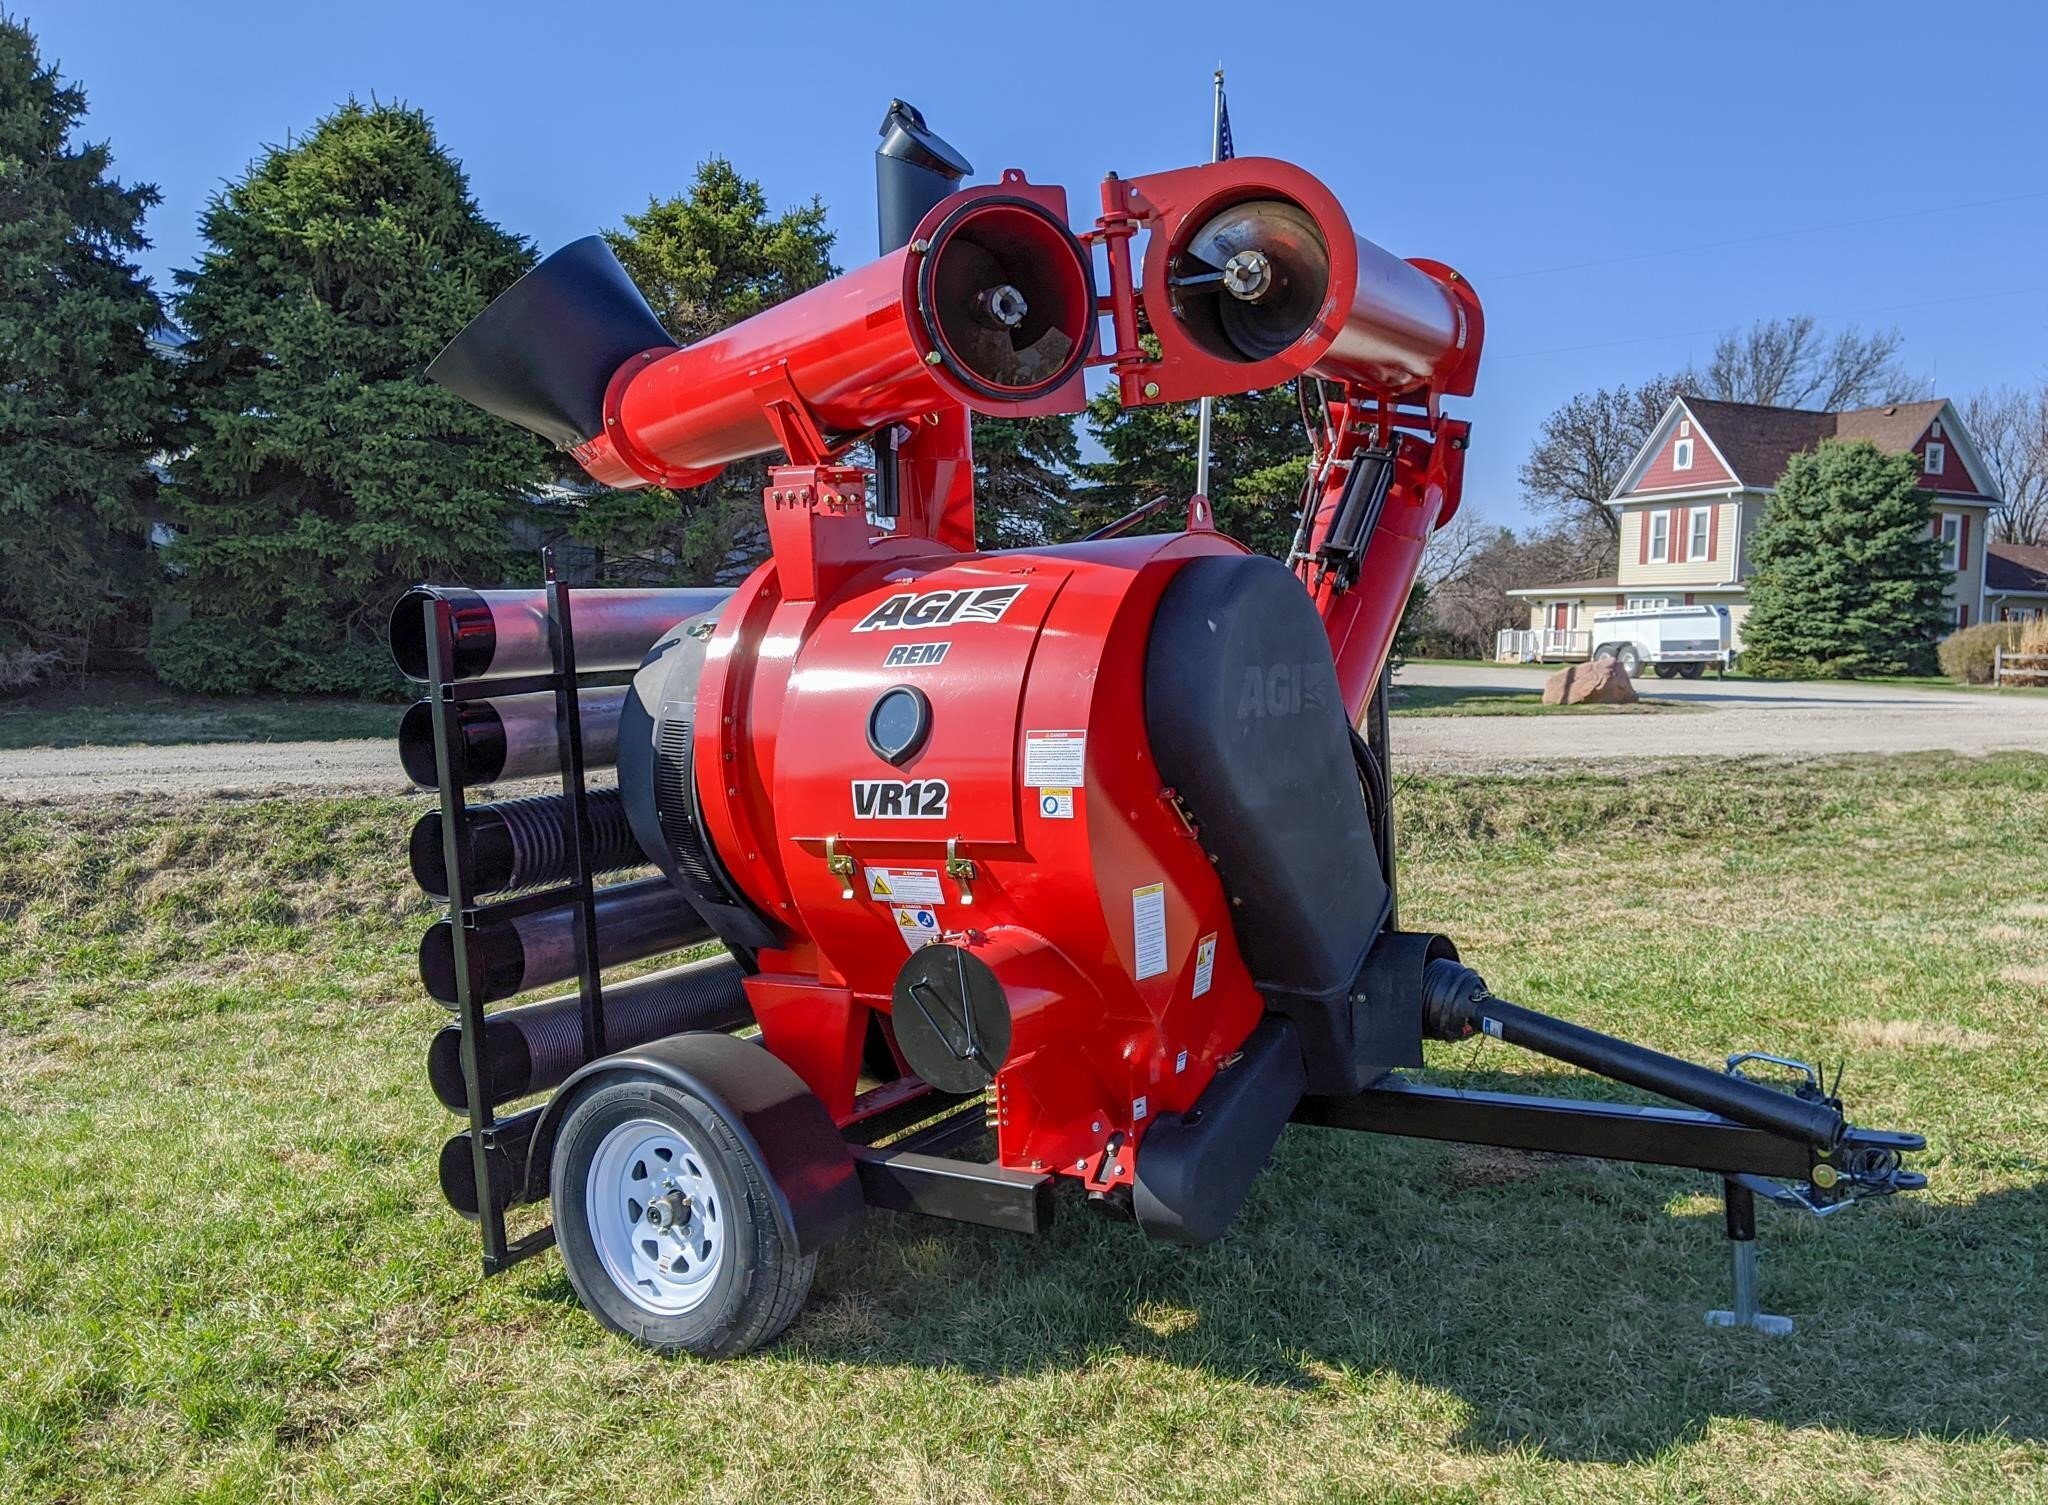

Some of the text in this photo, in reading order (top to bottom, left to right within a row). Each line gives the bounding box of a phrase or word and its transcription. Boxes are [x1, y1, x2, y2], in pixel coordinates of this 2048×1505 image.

[855, 588, 967, 630] AGI
[885, 643, 950, 666] REM
[1236, 662, 1302, 720] AGI
[854, 781, 947, 816] VR12
